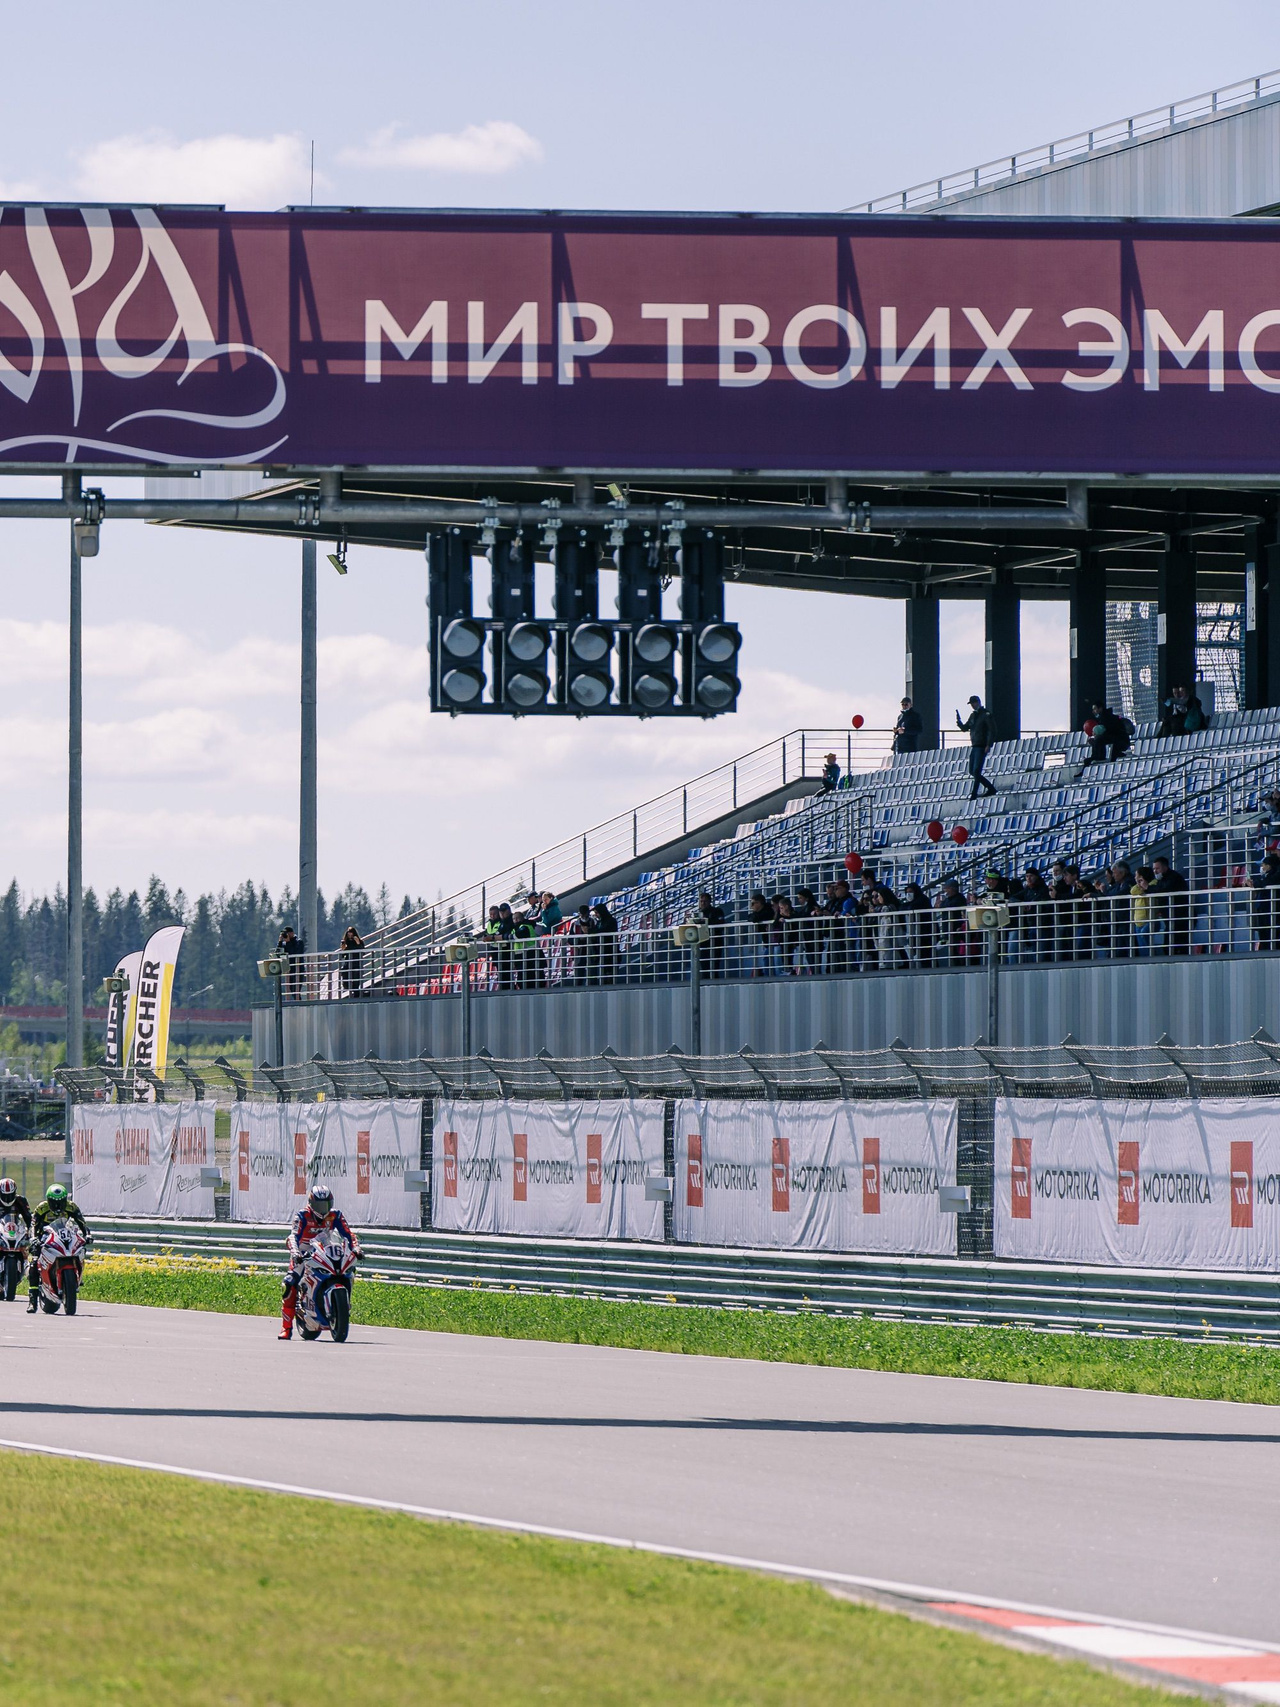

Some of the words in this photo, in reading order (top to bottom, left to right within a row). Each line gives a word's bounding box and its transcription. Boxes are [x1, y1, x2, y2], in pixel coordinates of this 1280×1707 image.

[364, 299, 614, 386] МИР
[640, 303, 1035, 391] ТВОИХ
[135, 959, 161, 1103] KRCHER
[123, 1127, 150, 1166] YAMAHA
[179, 1126, 207, 1165] YAMAHA
[459, 1159, 502, 1182] MOTORRIKA
[529, 1160, 575, 1185] MOTORRIKA
[705, 1163, 758, 1191] MOTORRIKA
[792, 1165, 848, 1192] MOTORRIKA
[883, 1166, 940, 1195] MOTORRIKA
[1035, 1169, 1100, 1201] MOTORRIKA
[1142, 1172, 1212, 1205] MOTORRIKA
[328, 1244, 342, 1258] 16
